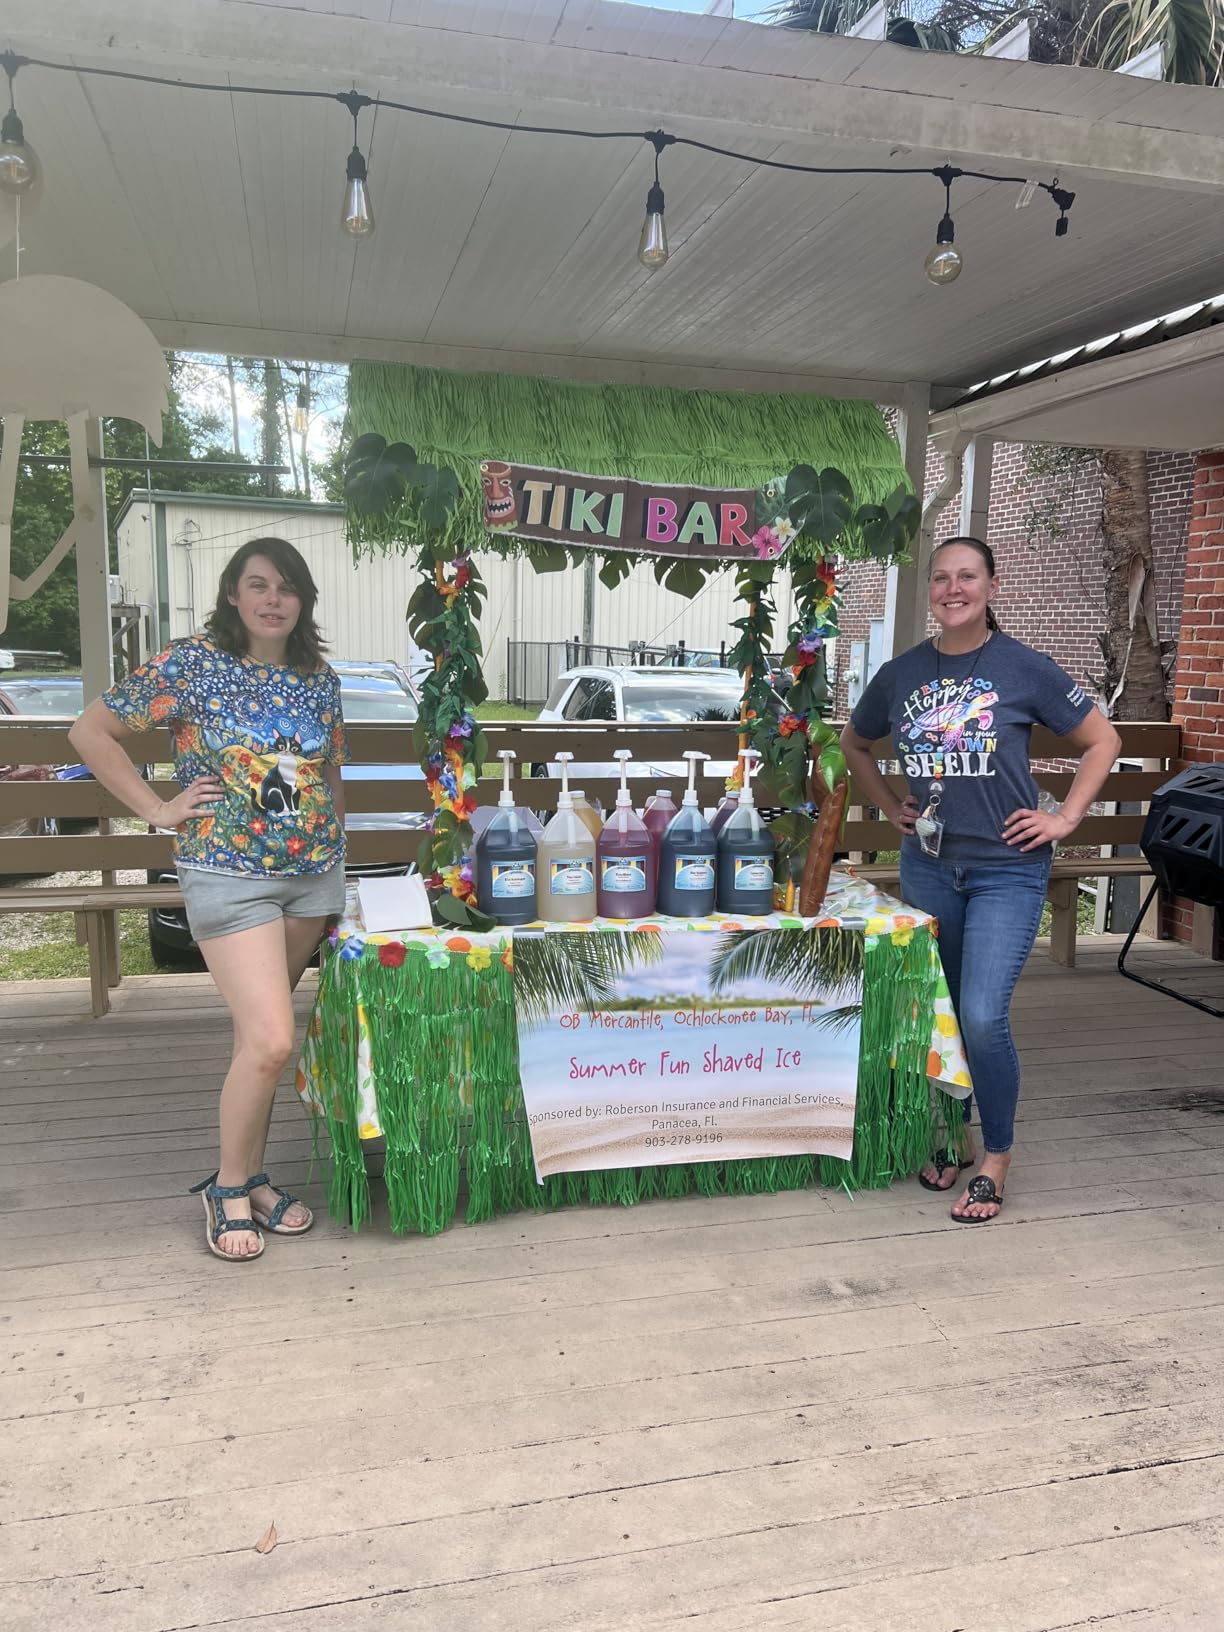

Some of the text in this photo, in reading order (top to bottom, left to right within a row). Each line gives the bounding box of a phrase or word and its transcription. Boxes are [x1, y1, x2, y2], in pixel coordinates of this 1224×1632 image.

[520, 479, 753, 546] TIKI BAR
[920, 680, 941, 696] BE
[903, 684, 974, 721] Happy
[957, 737, 997, 752] OWN
[975, 731, 997, 741] your
[904, 752, 996, 778] SHELL
[560, 1013, 581, 1029] OB
[590, 1008, 664, 1031] Mercantile,
[674, 1006, 756, 1027] Ochlockonee
[765, 1006, 793, 1025] Bay,
[569, 1044, 801, 1080] Summer Fun Shaved Ice
[529, 1093, 844, 1126] Sponsored by: Roberson Insurance and Financial Services,
[652, 1115, 718, 1130] Panacea, Fl.
[645, 1132, 723, 1148] 903-278-9196
